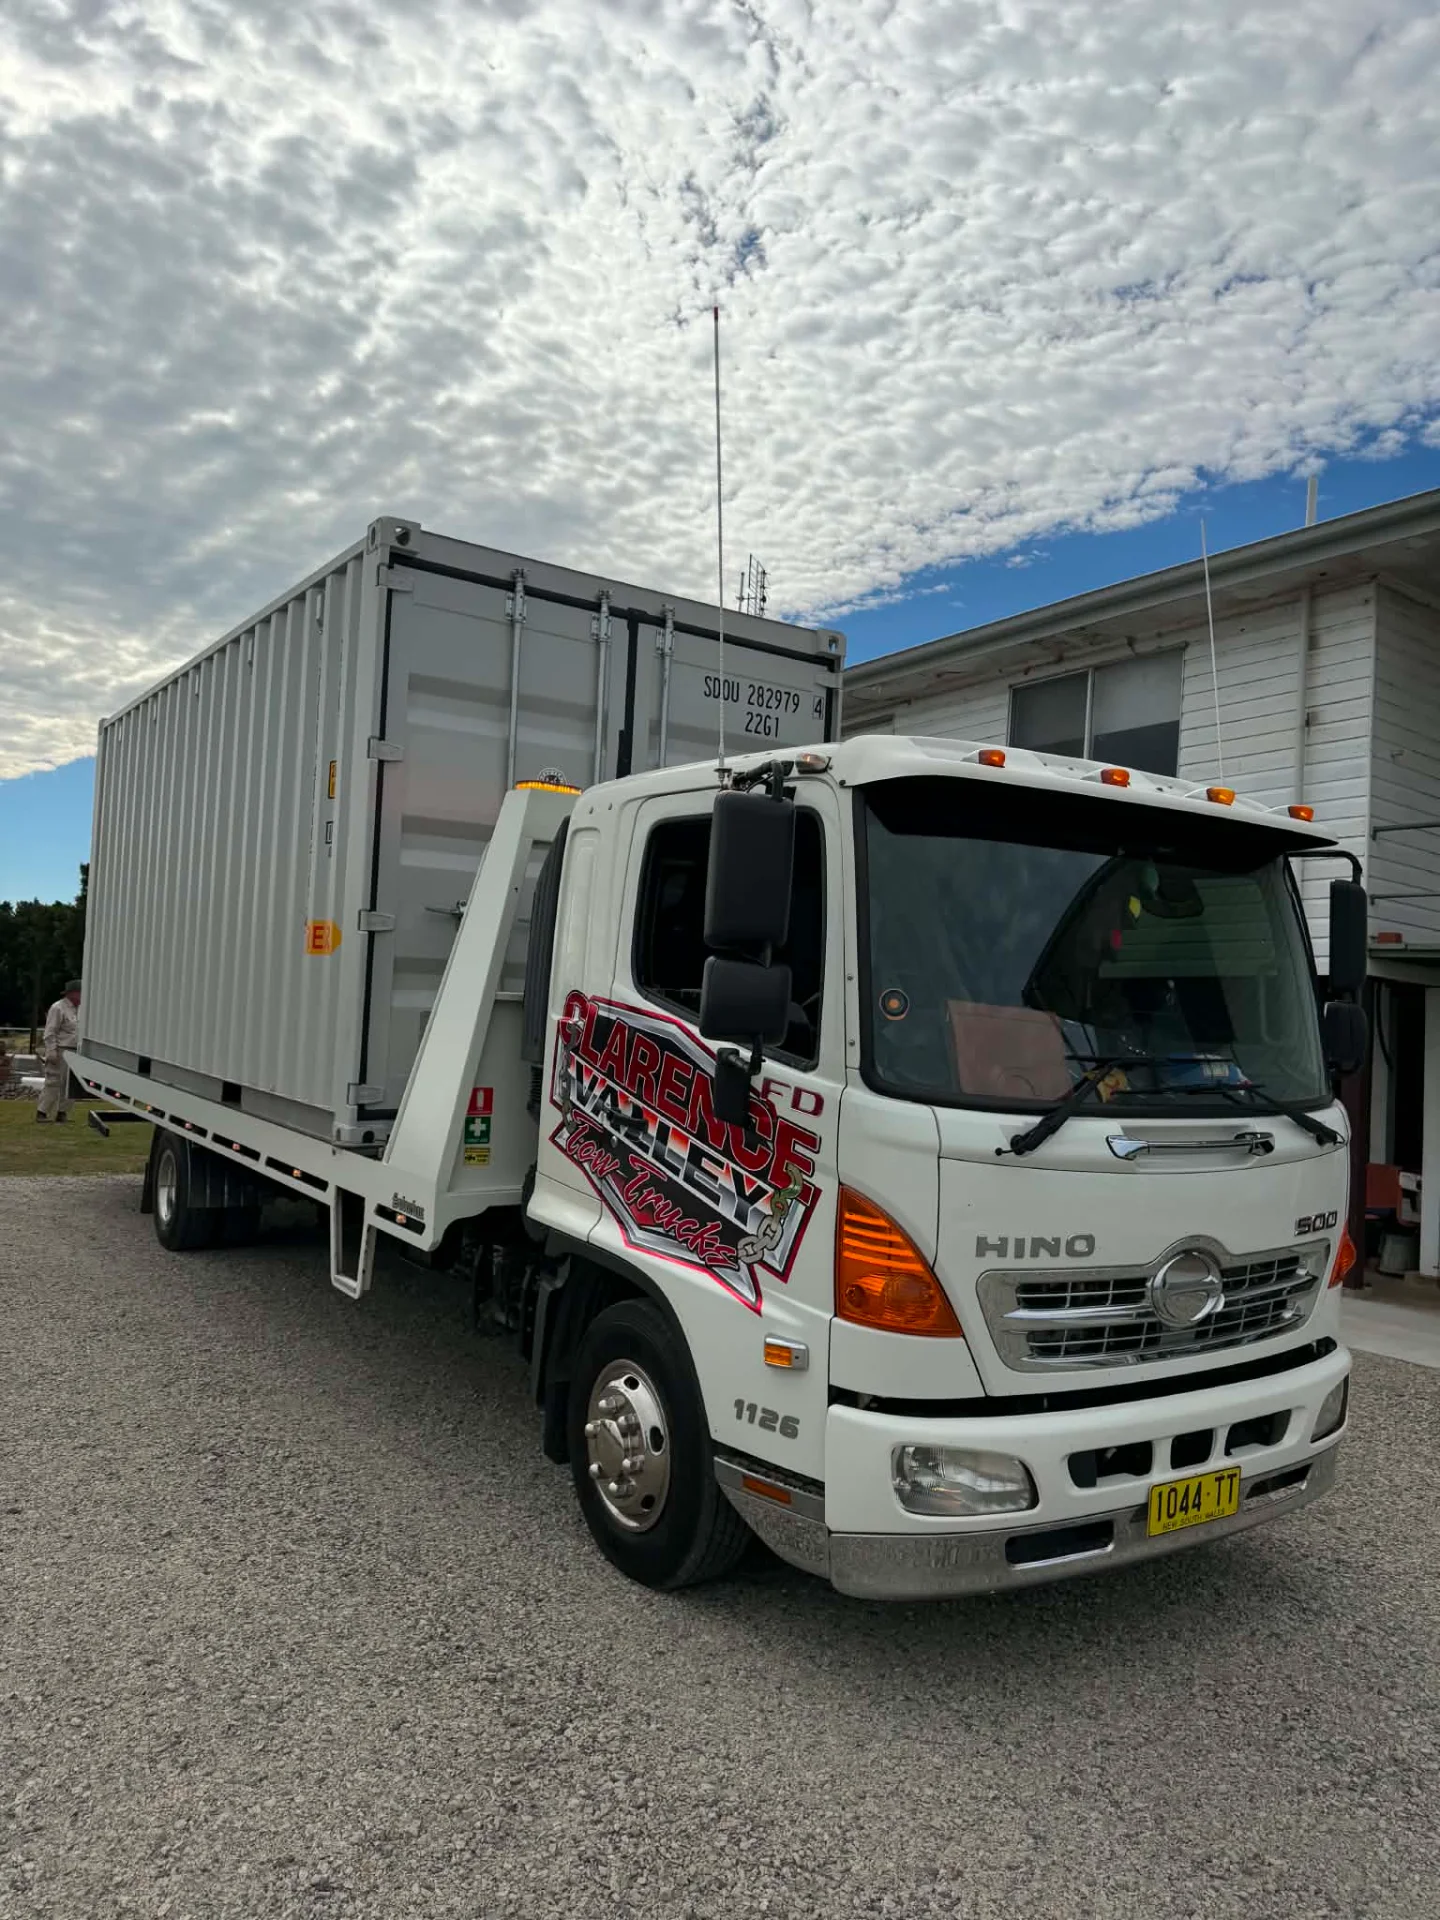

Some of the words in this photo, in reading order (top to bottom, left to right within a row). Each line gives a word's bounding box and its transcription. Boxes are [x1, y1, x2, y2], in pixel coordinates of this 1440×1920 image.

[703, 675, 740, 703] SDOU
[747, 683, 800, 714] 282979
[814, 697, 823, 720] 4
[745, 711, 779, 738] 22G1
[559, 990, 821, 1206] CLARENCE
[760, 1077, 825, 1117] FD
[1294, 1210, 1338, 1236] 500
[975, 1234, 1096, 1260] HINO
[734, 1399, 800, 1440] 1126
